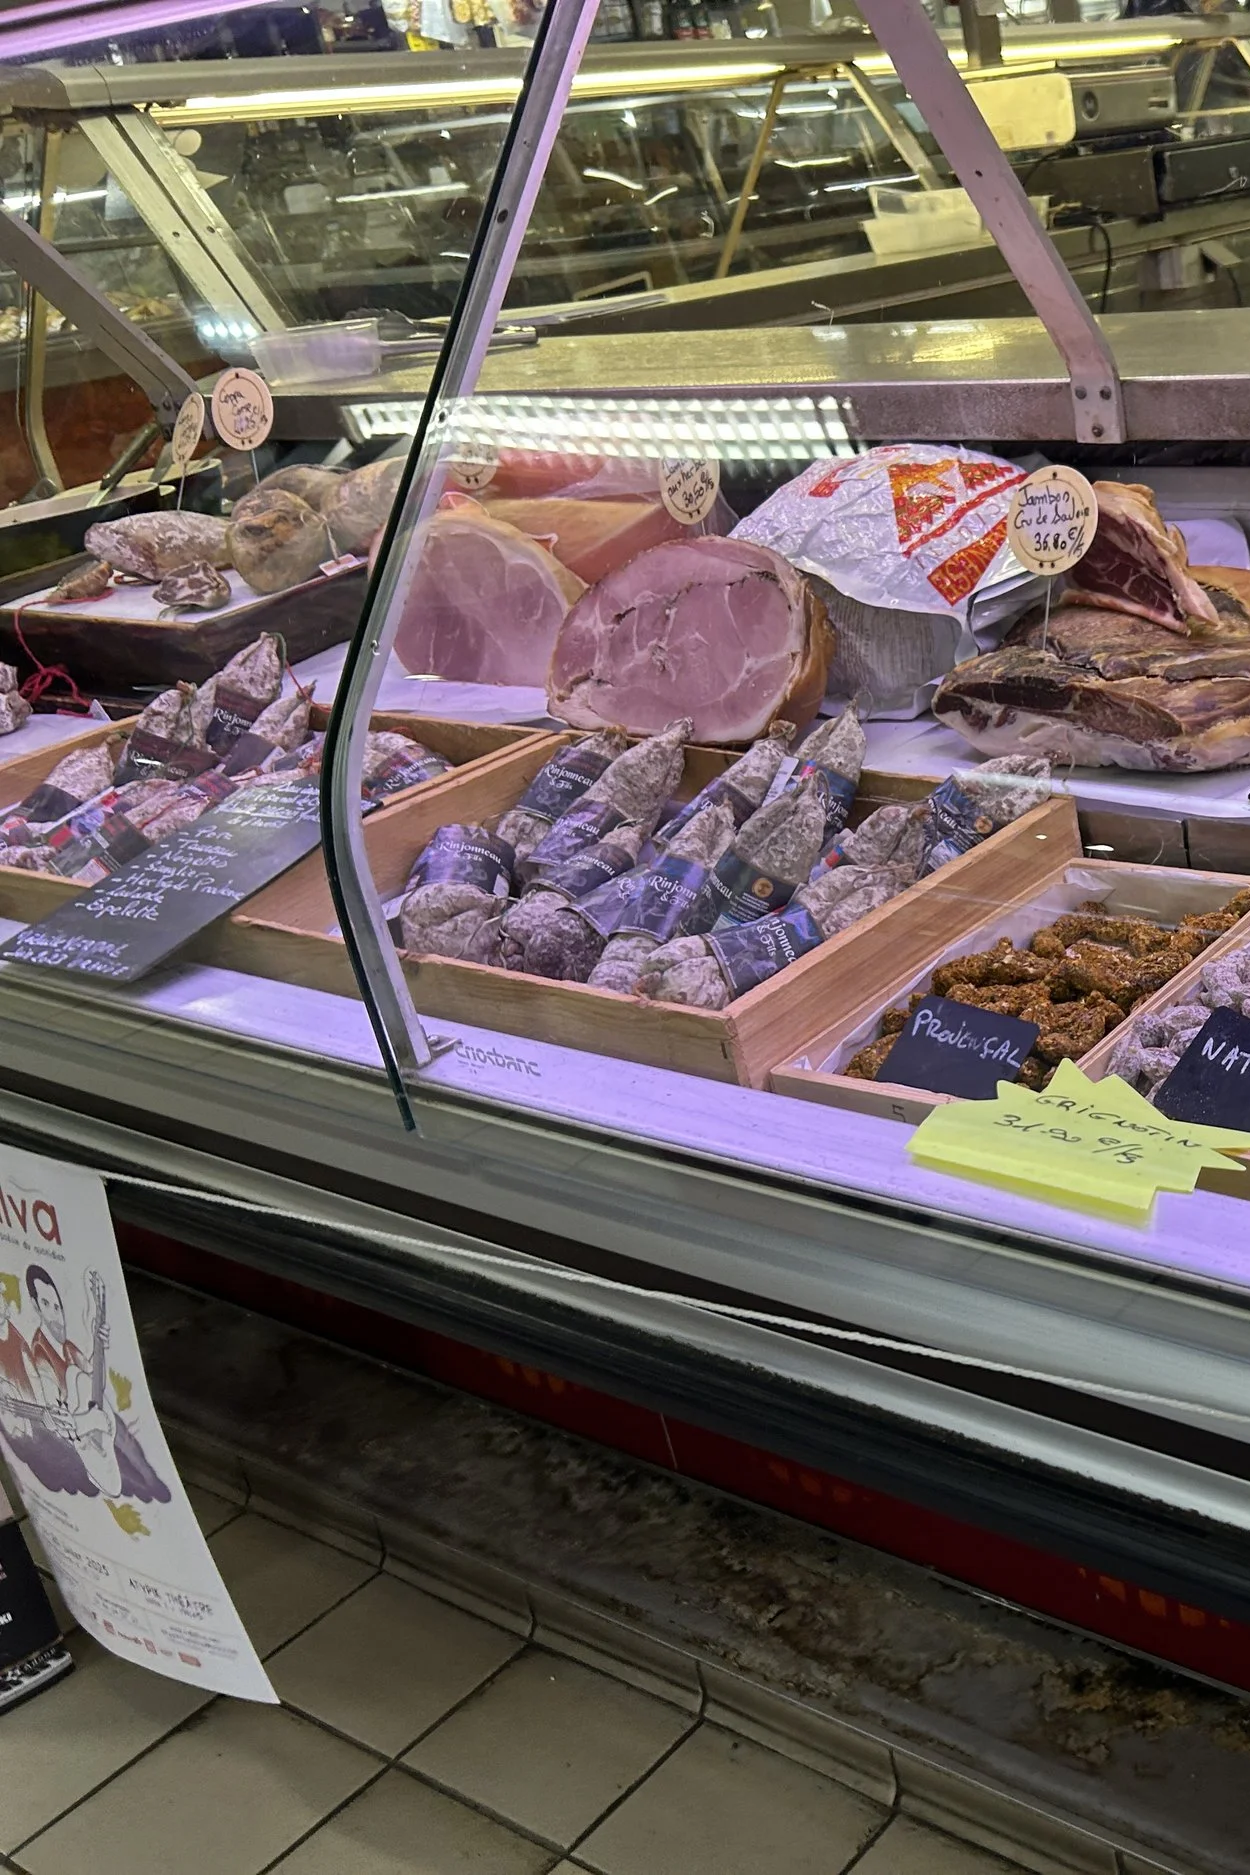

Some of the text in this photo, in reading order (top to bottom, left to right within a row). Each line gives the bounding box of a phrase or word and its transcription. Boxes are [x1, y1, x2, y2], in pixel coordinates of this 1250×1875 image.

[1018, 482, 1070, 507] Jambon
[1035, 505, 1048, 525] de
[435, 840, 502, 864] Rinjonneau
[648, 874, 698, 901] Rinjonn
[0, 1184, 62, 1246] lva
